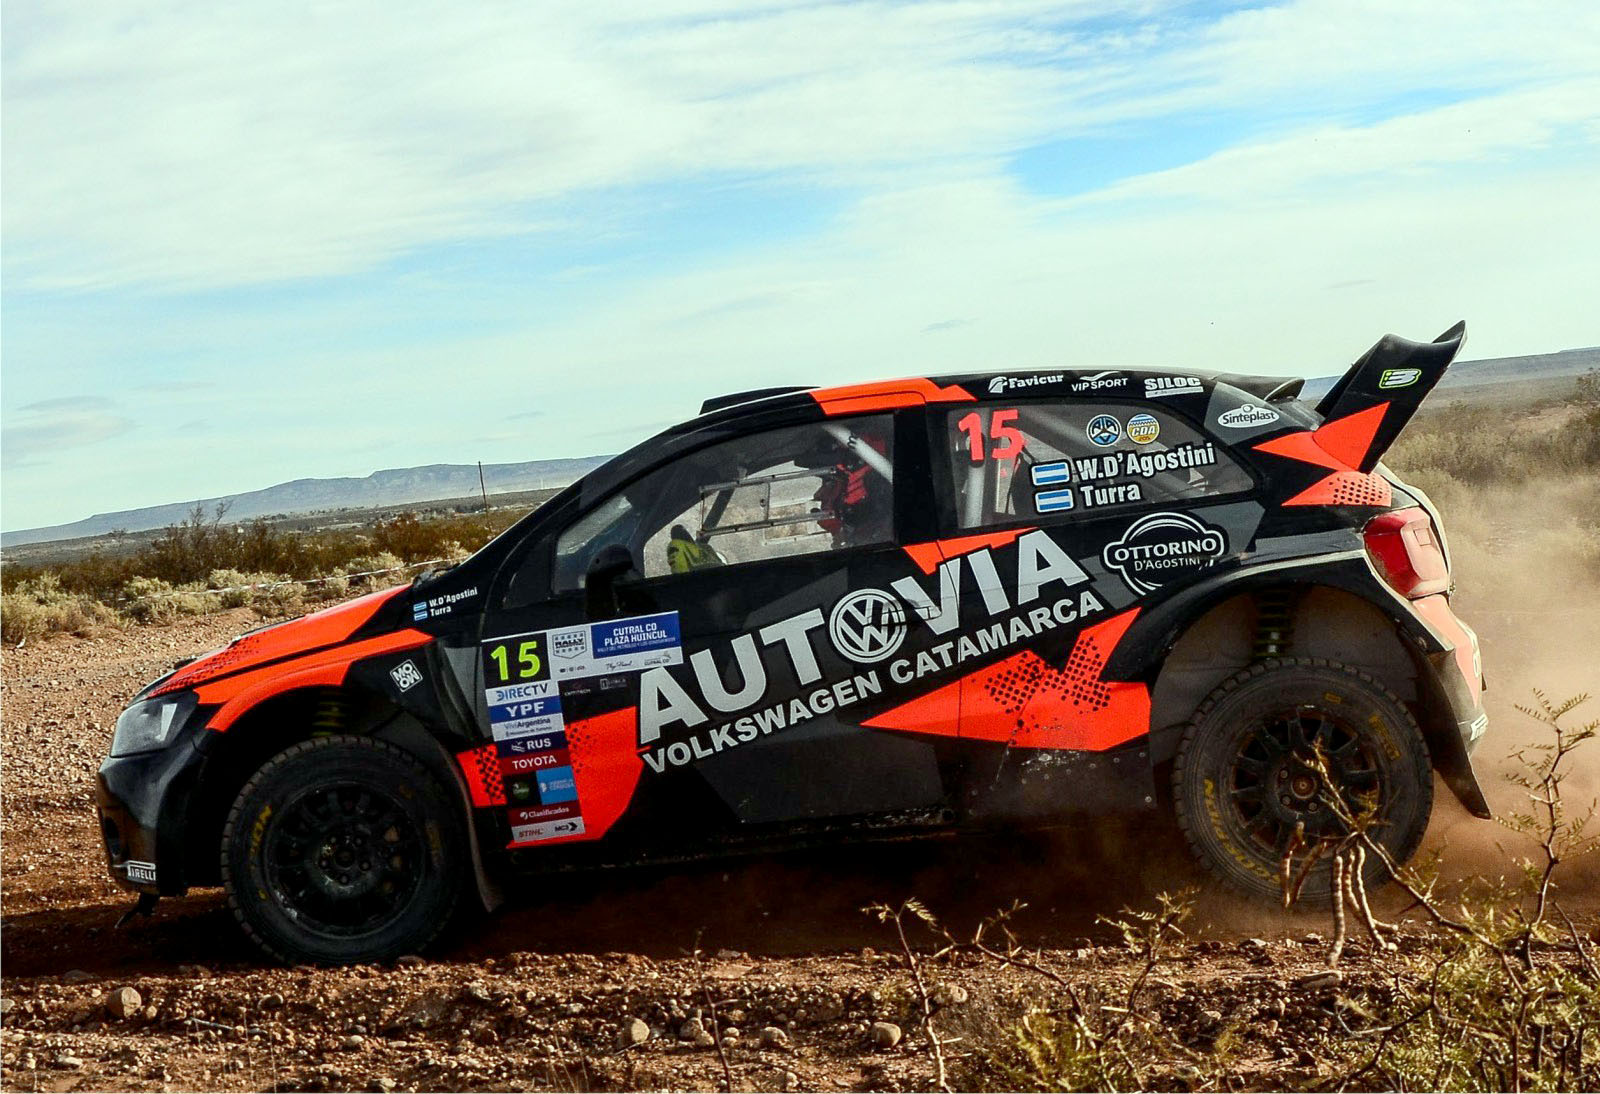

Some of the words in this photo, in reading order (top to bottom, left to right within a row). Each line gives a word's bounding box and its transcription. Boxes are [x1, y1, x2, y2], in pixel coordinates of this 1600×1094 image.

[1008, 374, 1063, 390] Favicur
[1144, 377, 1201, 391] SILOC
[1222, 410, 1276, 425] Sinteplast
[958, 409, 1027, 462] 15
[1080, 483, 1141, 507] Turra
[1114, 538, 1217, 561] OTTORINO
[430, 605, 452, 617] Turra
[613, 624, 645, 636] CUTRAL
[645, 622, 658, 632] CO
[555, 637, 584, 646] RALLY
[604, 635, 630, 647] PLAZA
[631, 629, 668, 643] HUINCUL
[890, 591, 1104, 684] CATAMARCA
[490, 641, 541, 681] 15
[495, 682, 548, 702] DIRECTV
[505, 701, 545, 717] YPF
[642, 670, 882, 774] VOLKSWAGEN
[526, 738, 552, 750] RUS
[512, 755, 557, 770] TOYOTA
[528, 806, 569, 819] Clasificados
